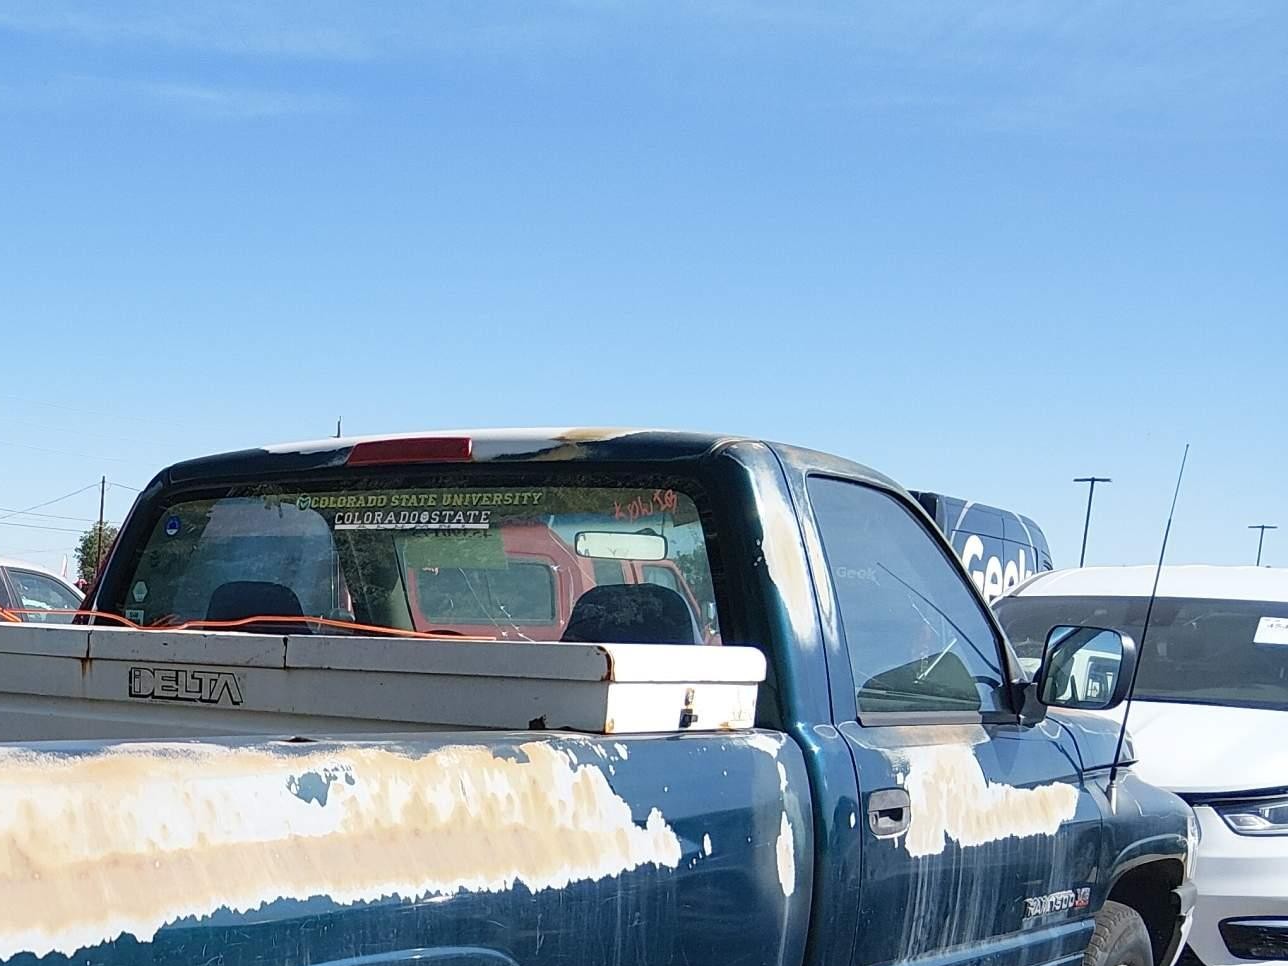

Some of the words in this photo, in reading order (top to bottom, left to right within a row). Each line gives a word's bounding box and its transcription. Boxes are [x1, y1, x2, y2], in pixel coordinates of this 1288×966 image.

[311, 496, 387, 509] COLORADO
[391, 495, 437, 507] STATE
[442, 492, 543, 506] UNIVERSITY
[335, 511, 421, 524] COLORADO
[430, 510, 491, 523] STATE
